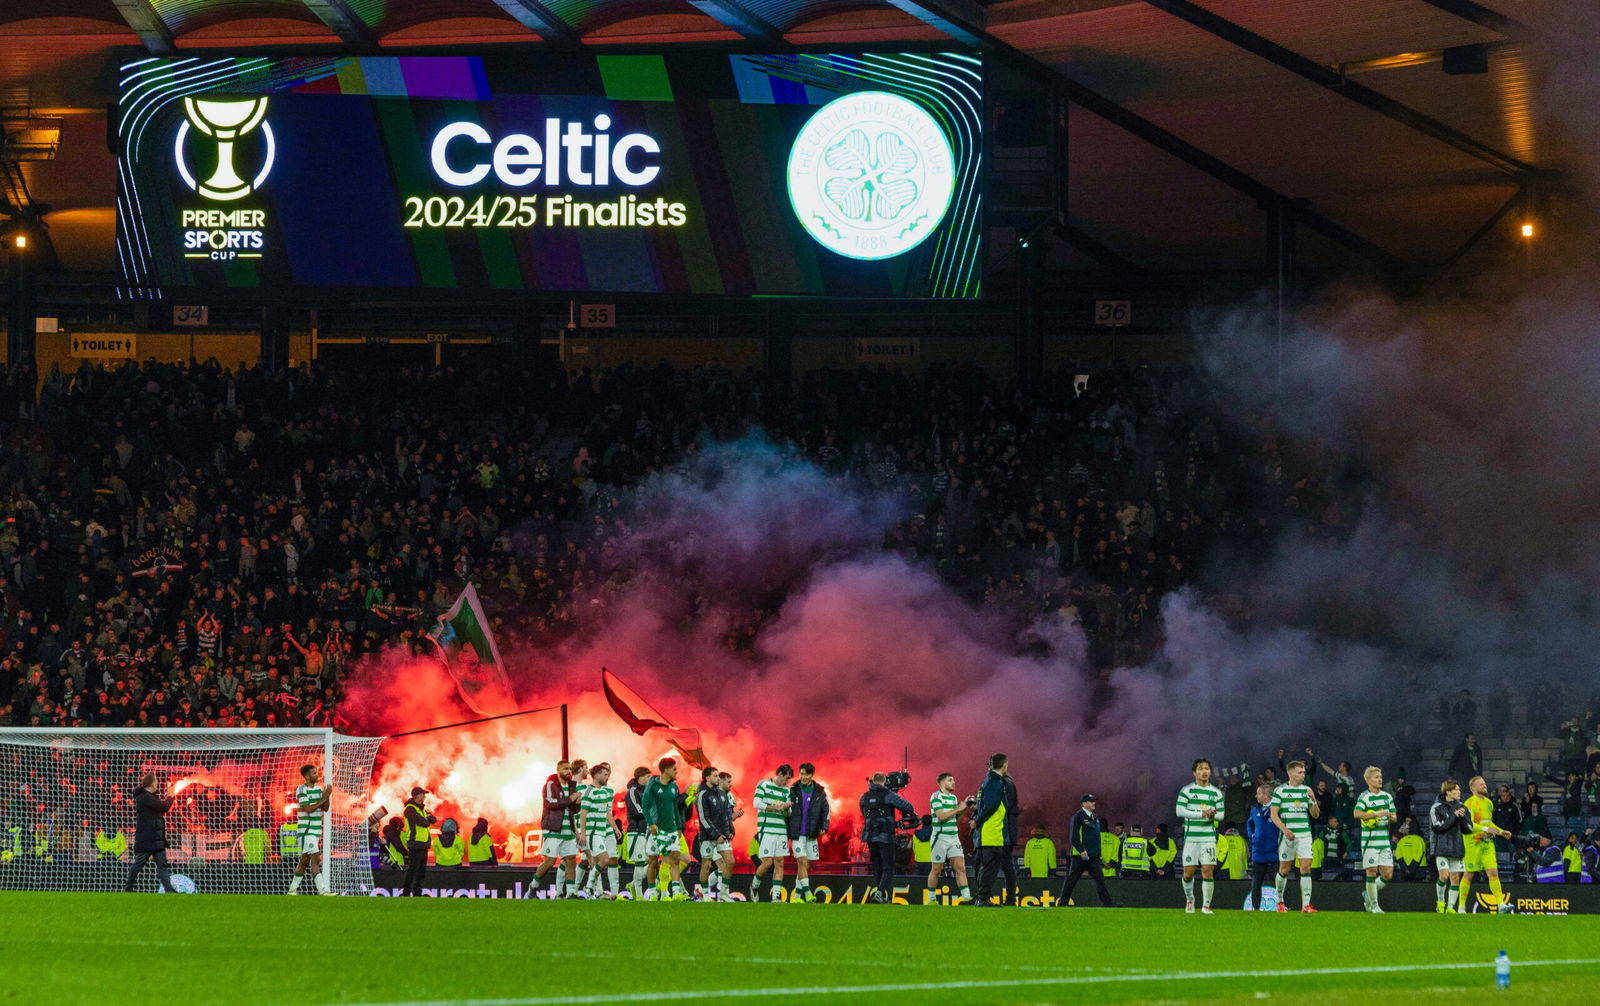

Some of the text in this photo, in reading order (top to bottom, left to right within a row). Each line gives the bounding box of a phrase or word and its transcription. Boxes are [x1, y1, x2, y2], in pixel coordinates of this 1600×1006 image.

[431, 114, 661, 186] Celtic
[182, 210, 266, 227] PREMIER
[404, 194, 687, 228] 2024/25 Finalists
[184, 230, 264, 249] SPORTS
[210, 251, 236, 260] CUP
[177, 305, 203, 322] 34
[587, 308, 608, 323] 35
[1099, 304, 1127, 320] 36
[81, 340, 122, 351] TOILET
[427, 333, 449, 343] EXIT
[866, 343, 908, 355] TOILET
[1206, 847, 1215, 857] 41
[1517, 898, 1569, 910] PREMIER
